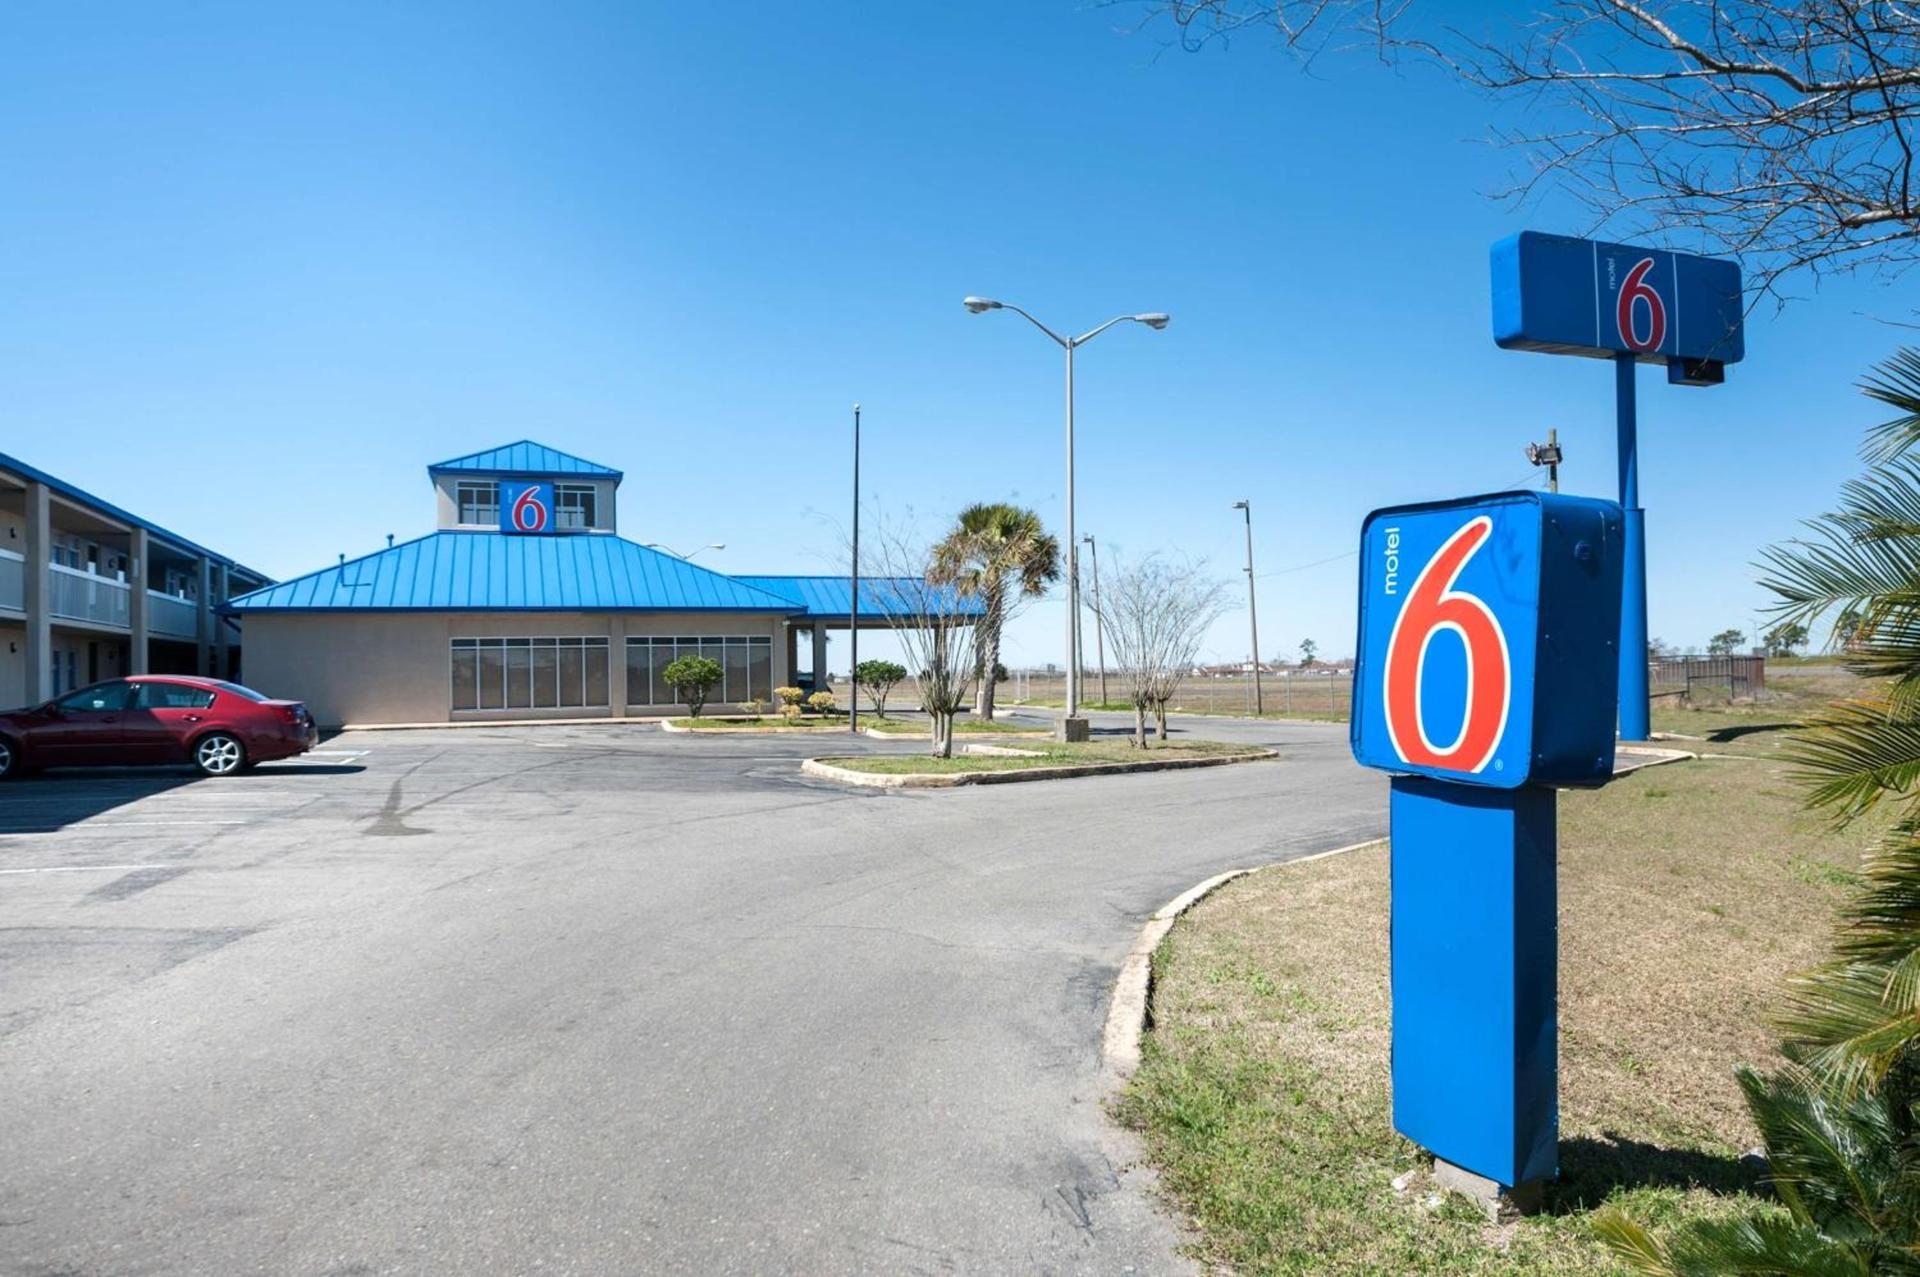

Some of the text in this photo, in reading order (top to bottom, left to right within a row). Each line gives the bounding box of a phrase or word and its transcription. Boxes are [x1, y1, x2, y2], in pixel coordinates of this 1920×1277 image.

[1607, 257, 1667, 352] motel 6
[512, 485, 547, 532] 6
[1383, 515, 1511, 774] motel 6
